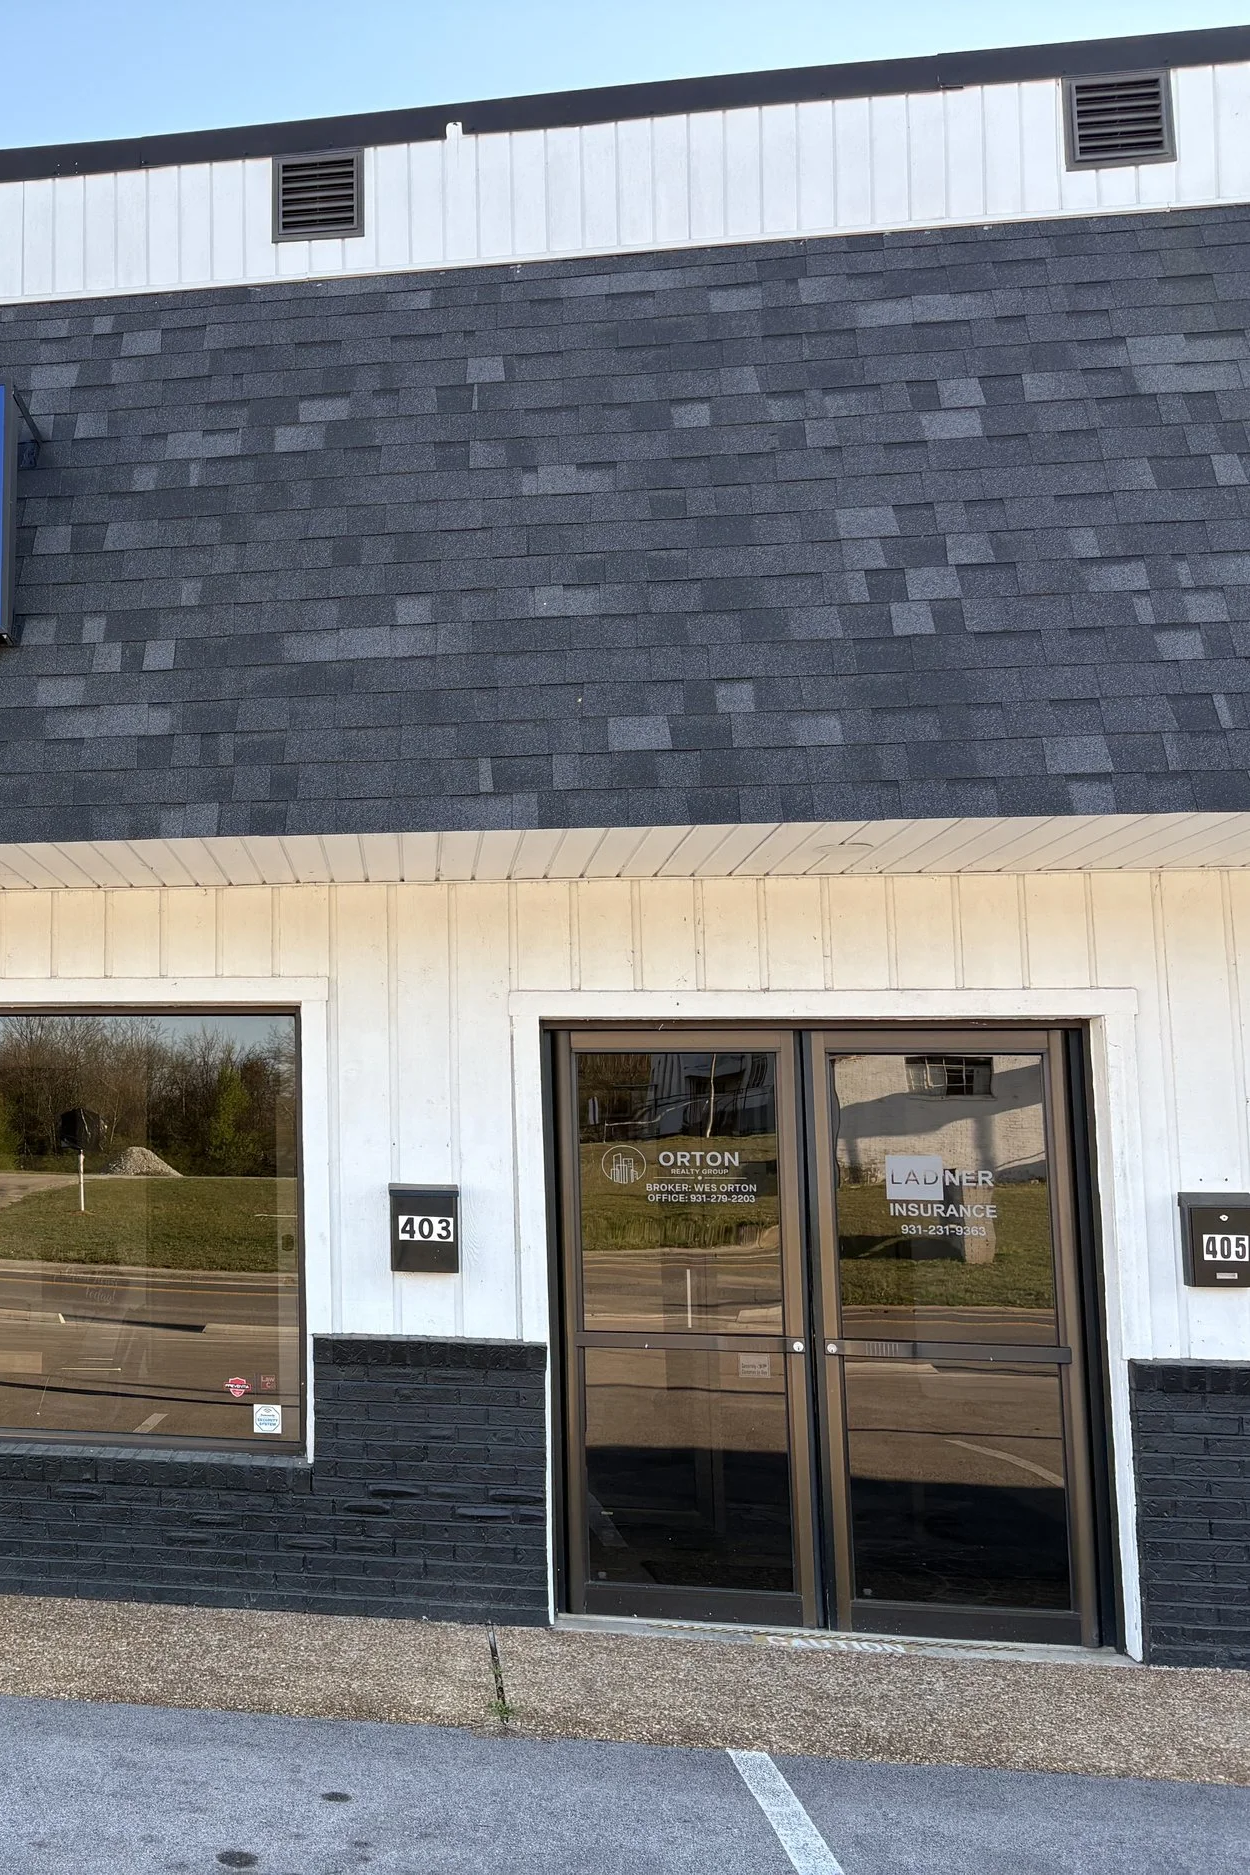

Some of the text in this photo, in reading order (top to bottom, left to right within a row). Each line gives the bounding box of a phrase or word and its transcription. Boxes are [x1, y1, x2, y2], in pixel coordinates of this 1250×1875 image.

[658, 1151, 740, 1167] ORTON
[891, 1169, 994, 1187] LADNER
[646, 1183, 757, 1193] BROKER: WES ORTON
[647, 1193, 756, 1203] OFFICE: 931-279-2203
[889, 1203, 998, 1218] INSURANCE
[401, 1217, 452, 1240] 403
[901, 1224, 987, 1236] 931-231-9363
[1205, 1236, 1247, 1259] 405
[765, 1636, 907, 1653] CAUTION
